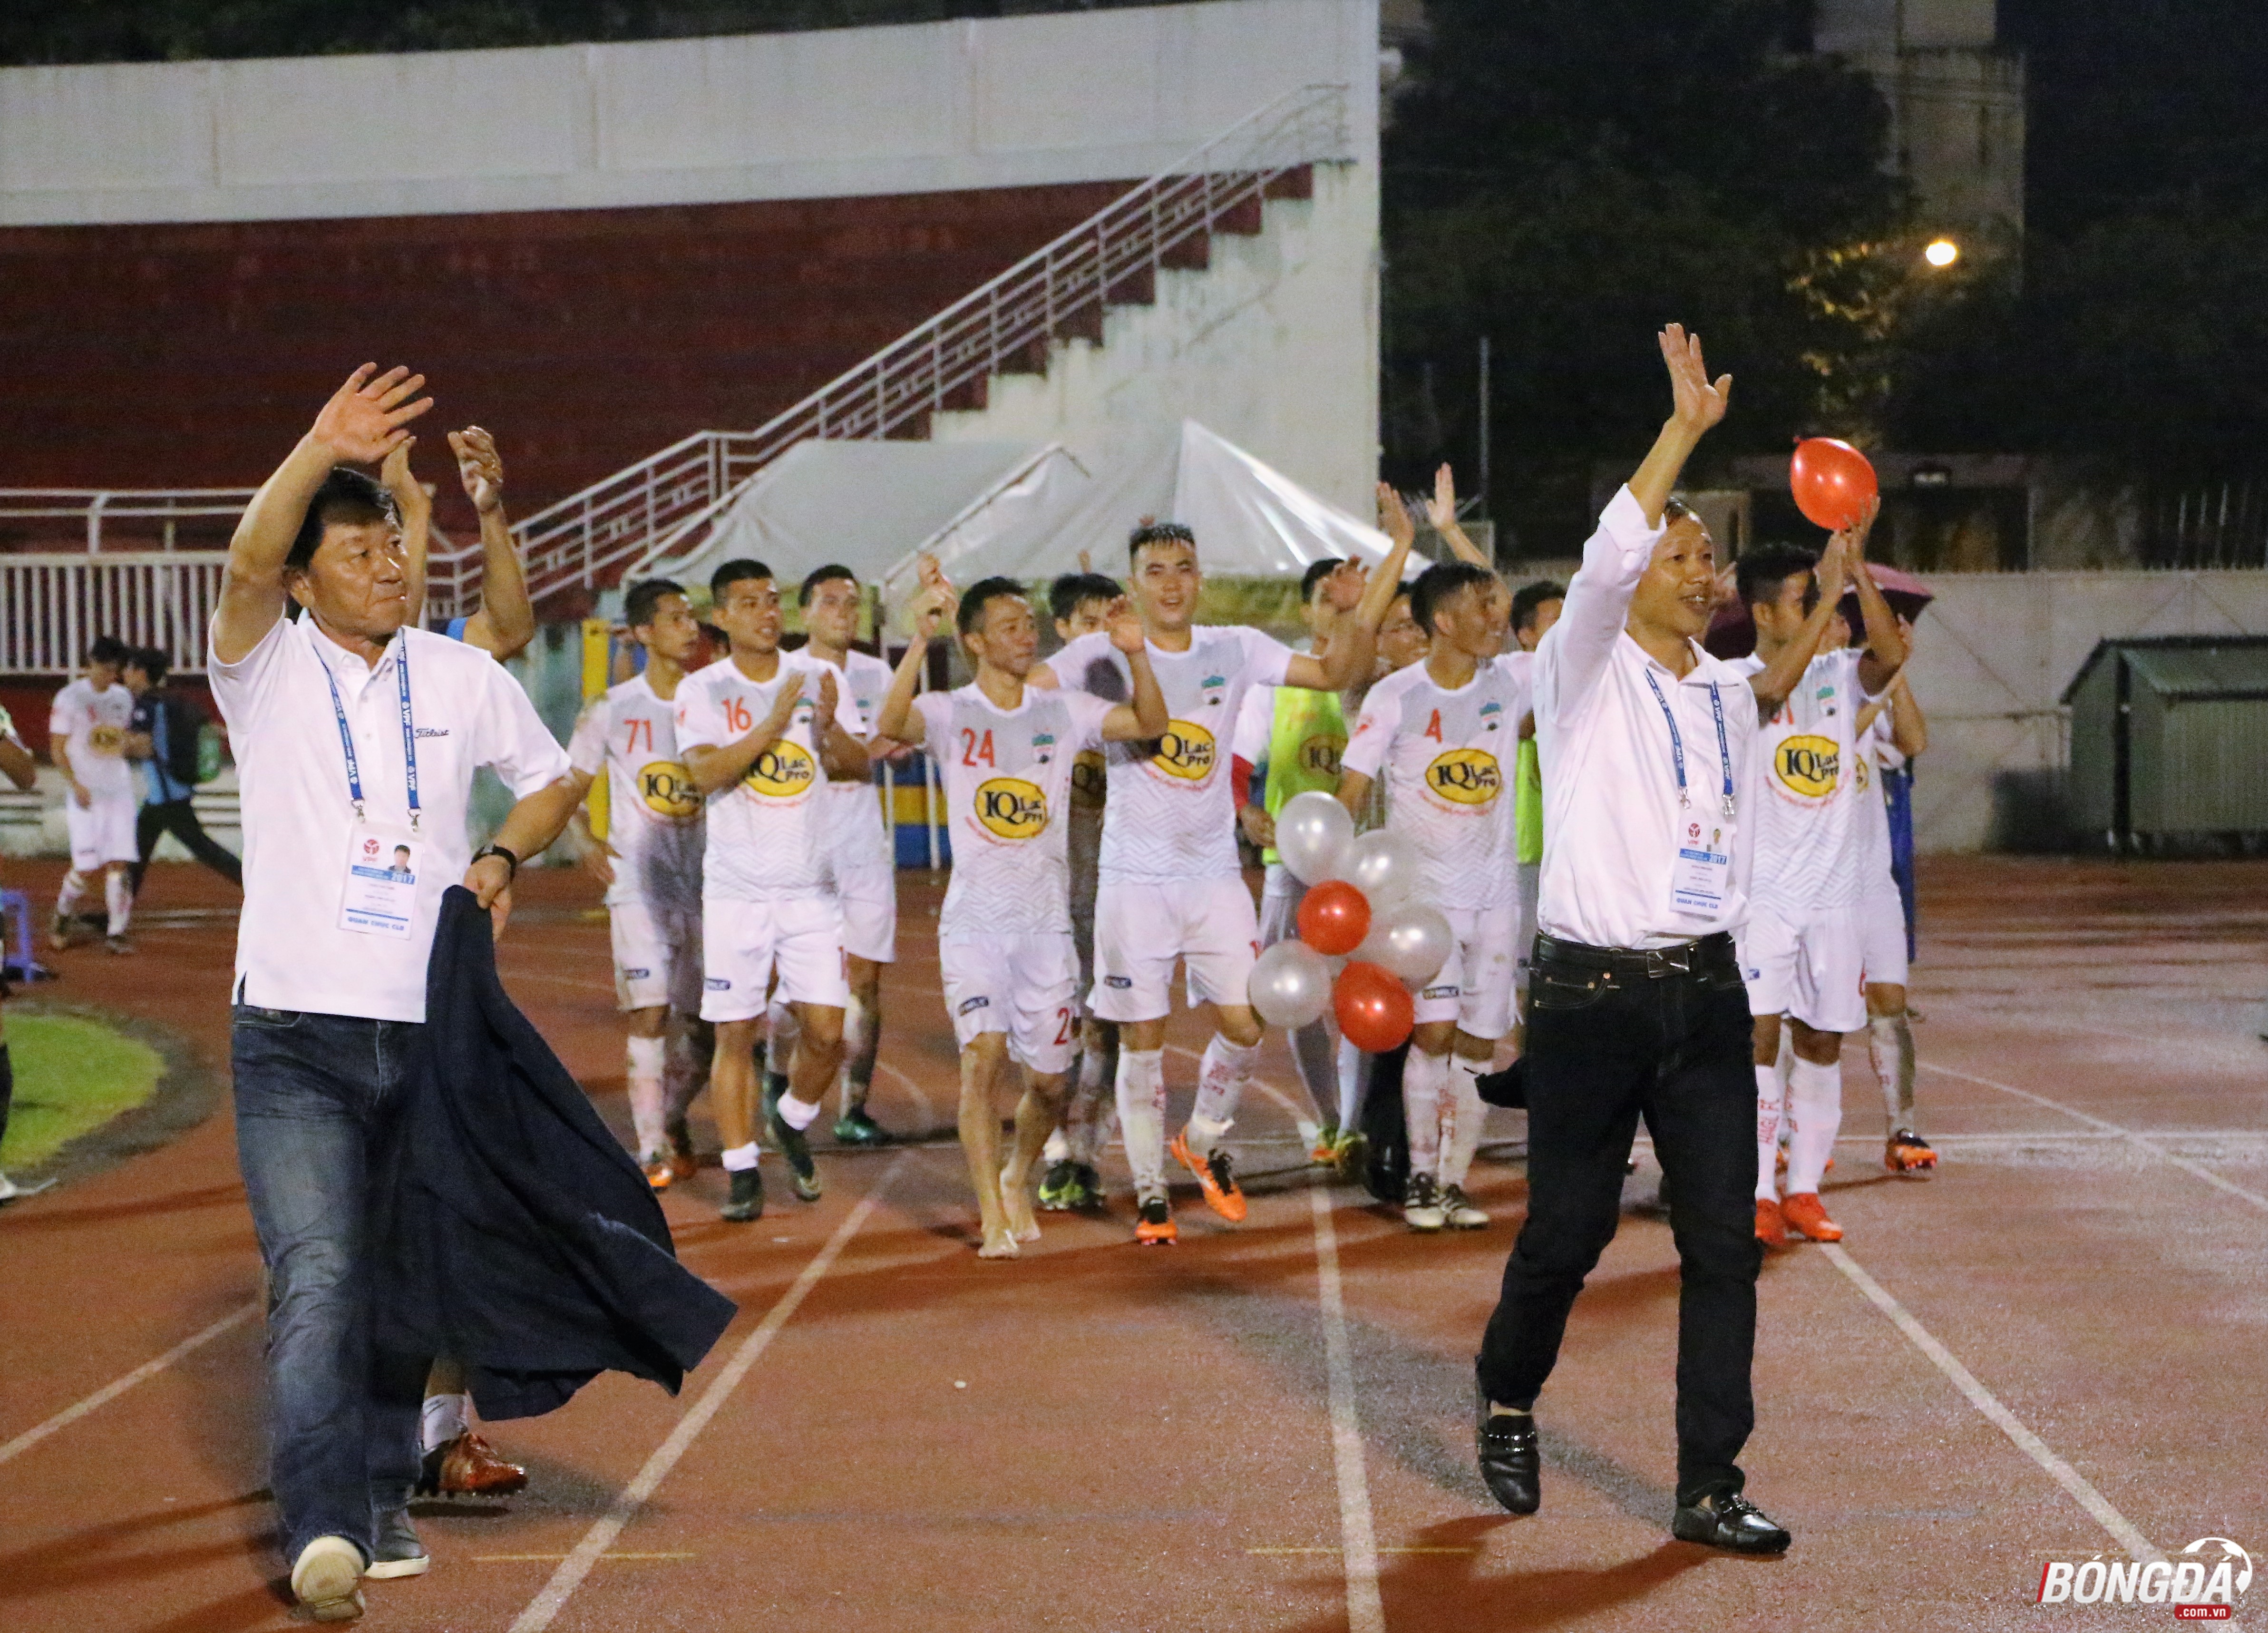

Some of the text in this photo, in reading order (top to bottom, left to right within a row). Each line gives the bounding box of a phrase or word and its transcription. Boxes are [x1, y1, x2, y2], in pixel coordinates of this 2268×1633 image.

[403, 709, 411, 725] VPF
[721, 696, 751, 733] 16
[1425, 708, 1442, 743] 4
[623, 719, 652, 753] 71
[962, 727, 994, 767] 24
[1185, 740, 1211, 753] Lac
[347, 759, 357, 777] VPF
[786, 771, 809, 781] Pro
[1437, 762, 1477, 790] IQ
[1786, 748, 1824, 782] IQ
[408, 774, 417, 791] VPF
[645, 773, 681, 804] IQ
[984, 792, 1021, 825] IQ
[391, 872, 415, 884] 2017
